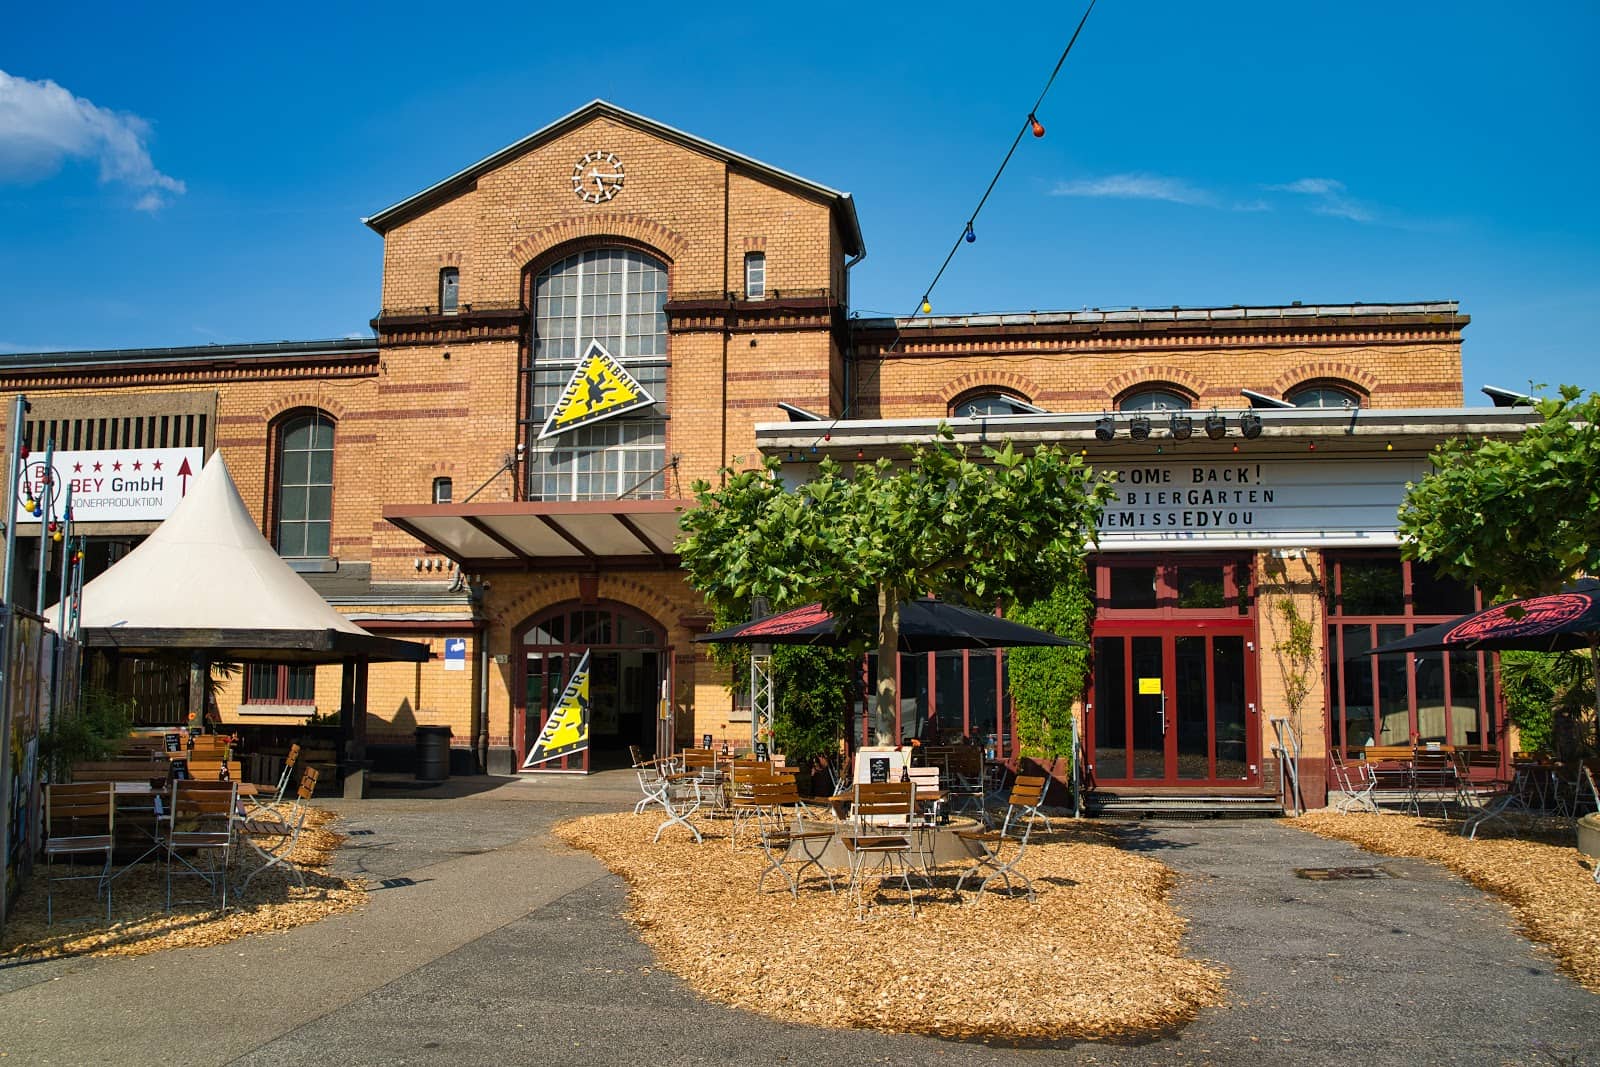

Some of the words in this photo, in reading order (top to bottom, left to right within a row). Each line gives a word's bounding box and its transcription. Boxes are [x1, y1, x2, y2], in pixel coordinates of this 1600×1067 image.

[554, 361, 593, 416] KULTUR
[600, 355, 641, 394] FABRIK
[71, 478, 104, 493] BEY
[112, 476, 164, 492] GmbH
[1069, 468, 1172, 485] WCOME
[1192, 464, 1261, 485] BACK!
[540, 675, 585, 741] KULTUR
